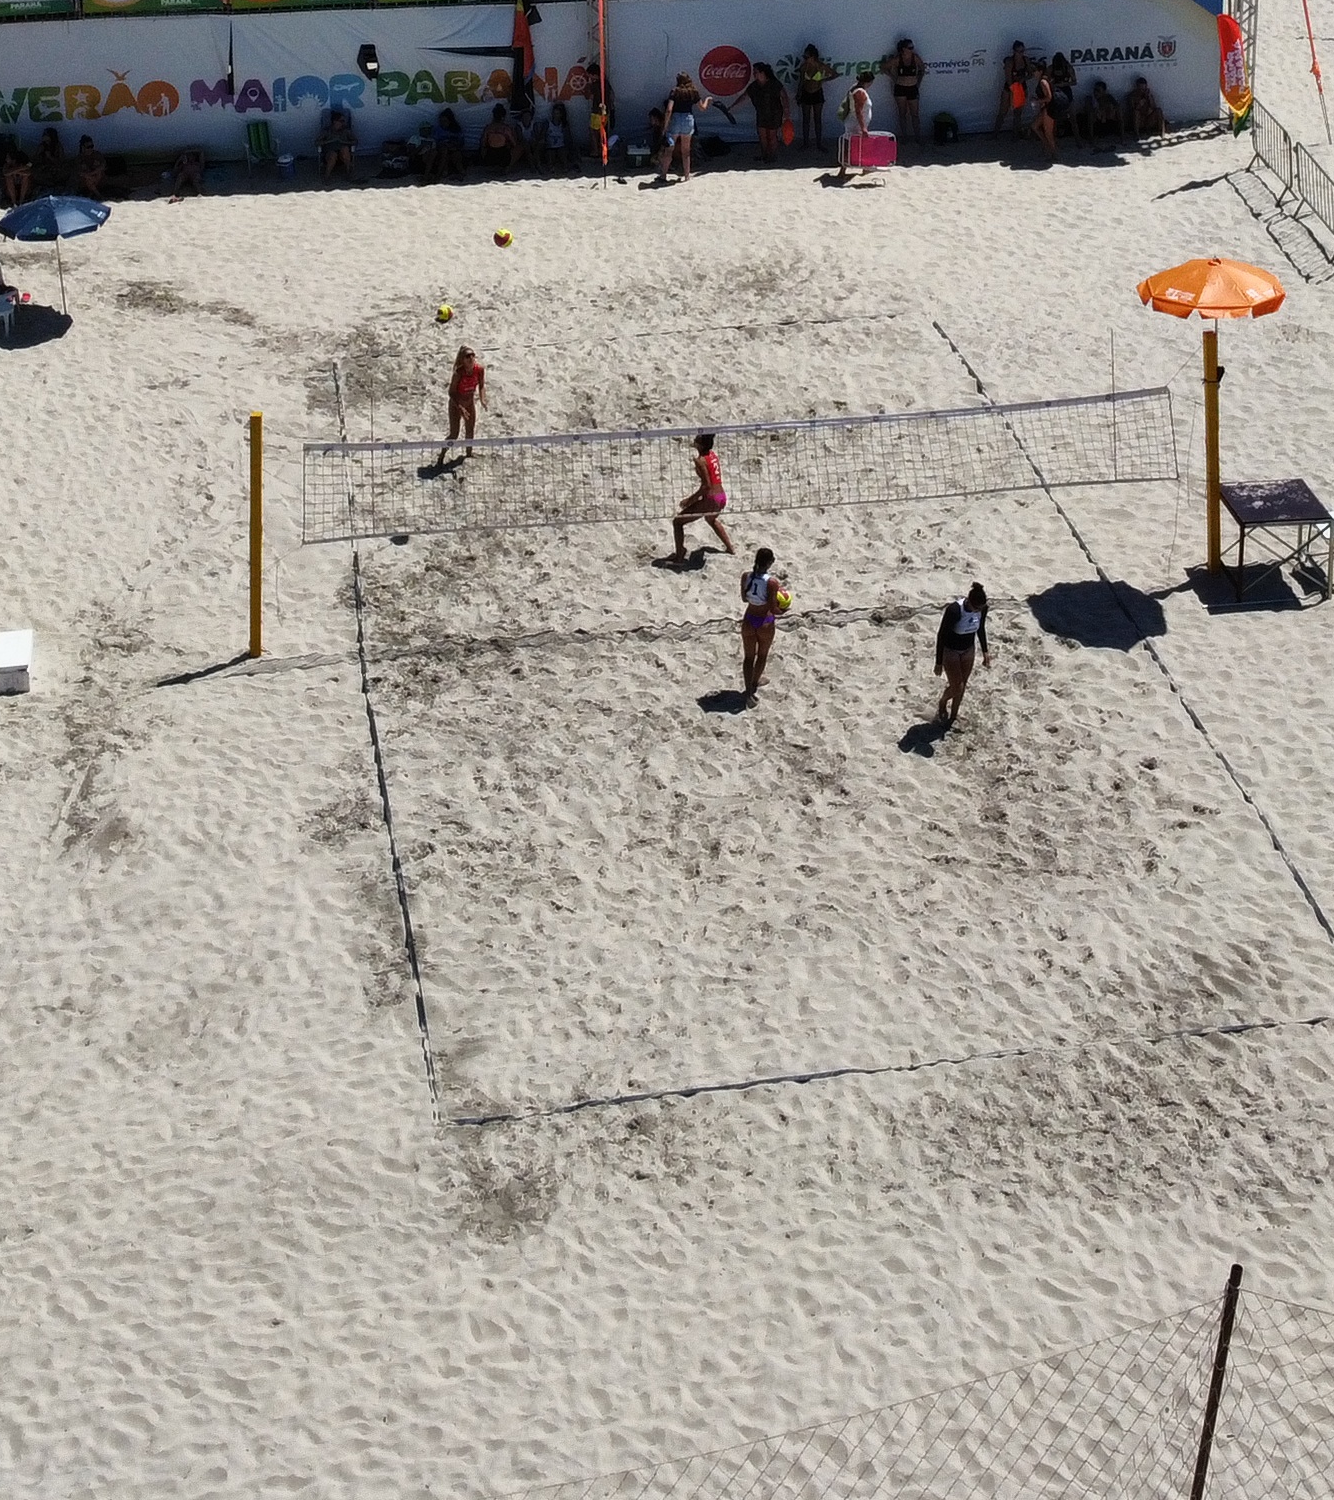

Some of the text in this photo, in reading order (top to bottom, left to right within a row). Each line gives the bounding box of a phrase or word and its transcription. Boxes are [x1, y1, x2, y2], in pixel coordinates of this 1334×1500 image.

[1070, 42, 1154, 64] PARANÁ
[701, 62, 747, 80] Coca-Cola
[919, 58, 970, 70] ecomércio
[190, 73, 365, 114] MAIOR
[752, 583, 759, 596] 1
